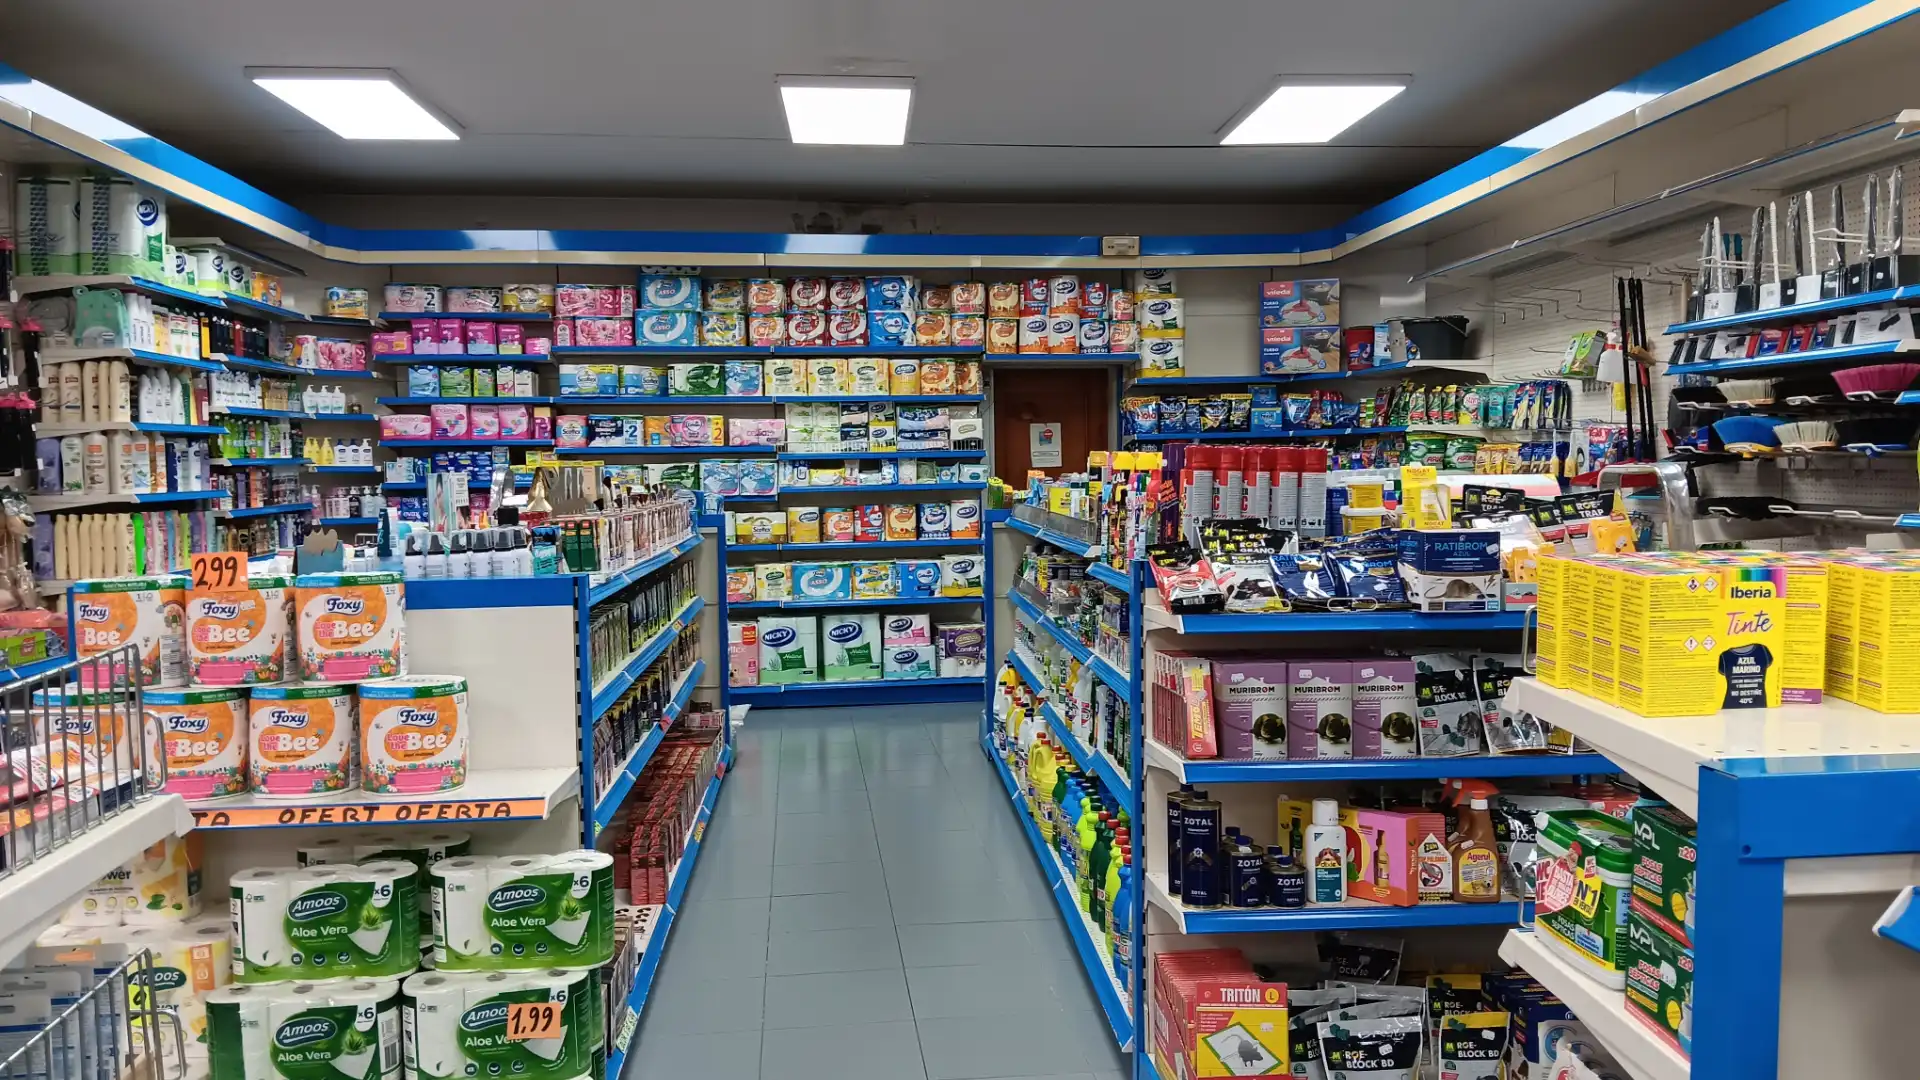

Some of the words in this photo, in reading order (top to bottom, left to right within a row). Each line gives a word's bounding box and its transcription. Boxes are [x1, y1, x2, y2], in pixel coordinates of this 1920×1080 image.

[1578, 508, 1604, 518] TRAP
[1434, 542, 1488, 551] RATIBROM
[194, 556, 238, 590] 2,99
[1730, 586, 1772, 598] Iberia
[80, 604, 108, 619] Foxy
[202, 602, 237, 616] Foxy
[326, 598, 362, 612] Foxy
[334, 620, 375, 638] Bee
[832, 624, 854, 636] NICKY
[1726, 610, 1774, 636] Tinte
[84, 628, 120, 646] Bee
[208, 625, 250, 642] Bee
[764, 631, 788, 641] NICKY
[1737, 656, 1756, 664] AZUL
[1732, 665, 1760, 674] MARINO
[1229, 686, 1275, 694] MURIBROM
[1358, 684, 1404, 692] MURIBROM
[168, 716, 206, 730] Foxy
[271, 710, 307, 725] Foxy
[400, 710, 436, 724] Foxy
[176, 738, 220, 756] Bee
[278, 733, 320, 751] Bee
[406, 732, 448, 750] Bee
[278, 807, 380, 824] OFERT
[395, 803, 512, 822] OFERTA
[1184, 817, 1212, 826] ZOTAL
[1634, 820, 1660, 850] MPL
[1237, 858, 1263, 867] ZOTAL
[1642, 856, 1662, 873] FOSAS
[574, 876, 589, 888] x6
[1278, 878, 1304, 886] ZOTAL
[374, 884, 390, 898] x6
[492, 888, 539, 903] Amoos
[292, 896, 340, 912] Amoos
[491, 918, 518, 927] Aloe
[520, 916, 546, 926] Vera
[292, 927, 317, 938] Aloe
[321, 926, 348, 936] Vera
[1630, 923, 1660, 956] MPL
[1639, 960, 1661, 979] FOSAS
[551, 990, 566, 1002] x6
[1220, 986, 1260, 1003] TRITÓN
[358, 1007, 374, 1019] x6
[512, 1006, 553, 1034] 1,99
[280, 1022, 330, 1038] Amoos
[465, 1036, 492, 1046] Aloe
[1457, 1041, 1477, 1049] ROE-
[278, 1052, 302, 1062] Aloe
[306, 1051, 332, 1060] Vera
[1458, 1050, 1486, 1058] BLOCK
[1346, 1060, 1378, 1068] BLOCK
[1381, 1059, 1394, 1068] BD
